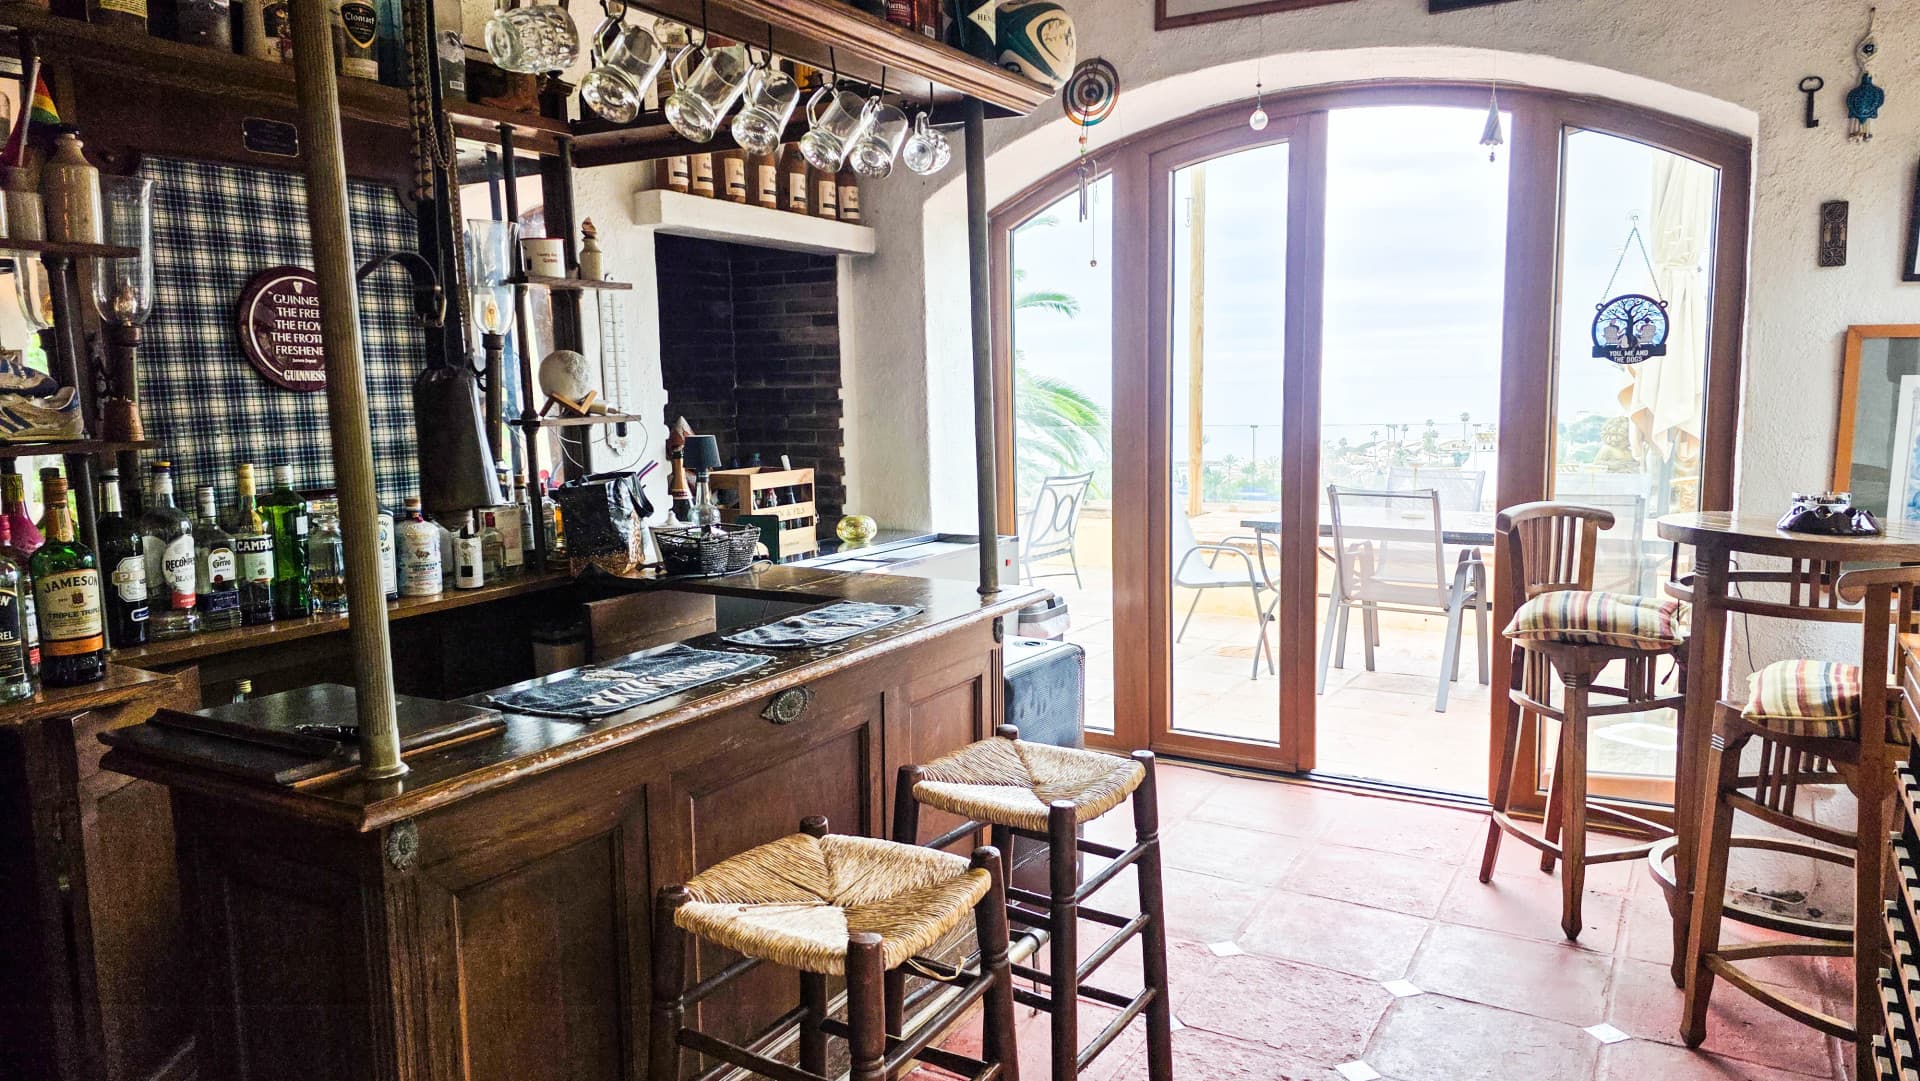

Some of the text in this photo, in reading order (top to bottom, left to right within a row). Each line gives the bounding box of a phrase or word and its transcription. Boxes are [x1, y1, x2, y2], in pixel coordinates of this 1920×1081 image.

[344, 12, 375, 25] Clontarf
[273, 293, 319, 306] GUINNES
[276, 306, 297, 318] THE
[275, 319, 295, 330] THE
[271, 332, 292, 343] THE
[283, 369, 326, 382] GUINNESS
[44, 575, 98, 594] JAMESON
